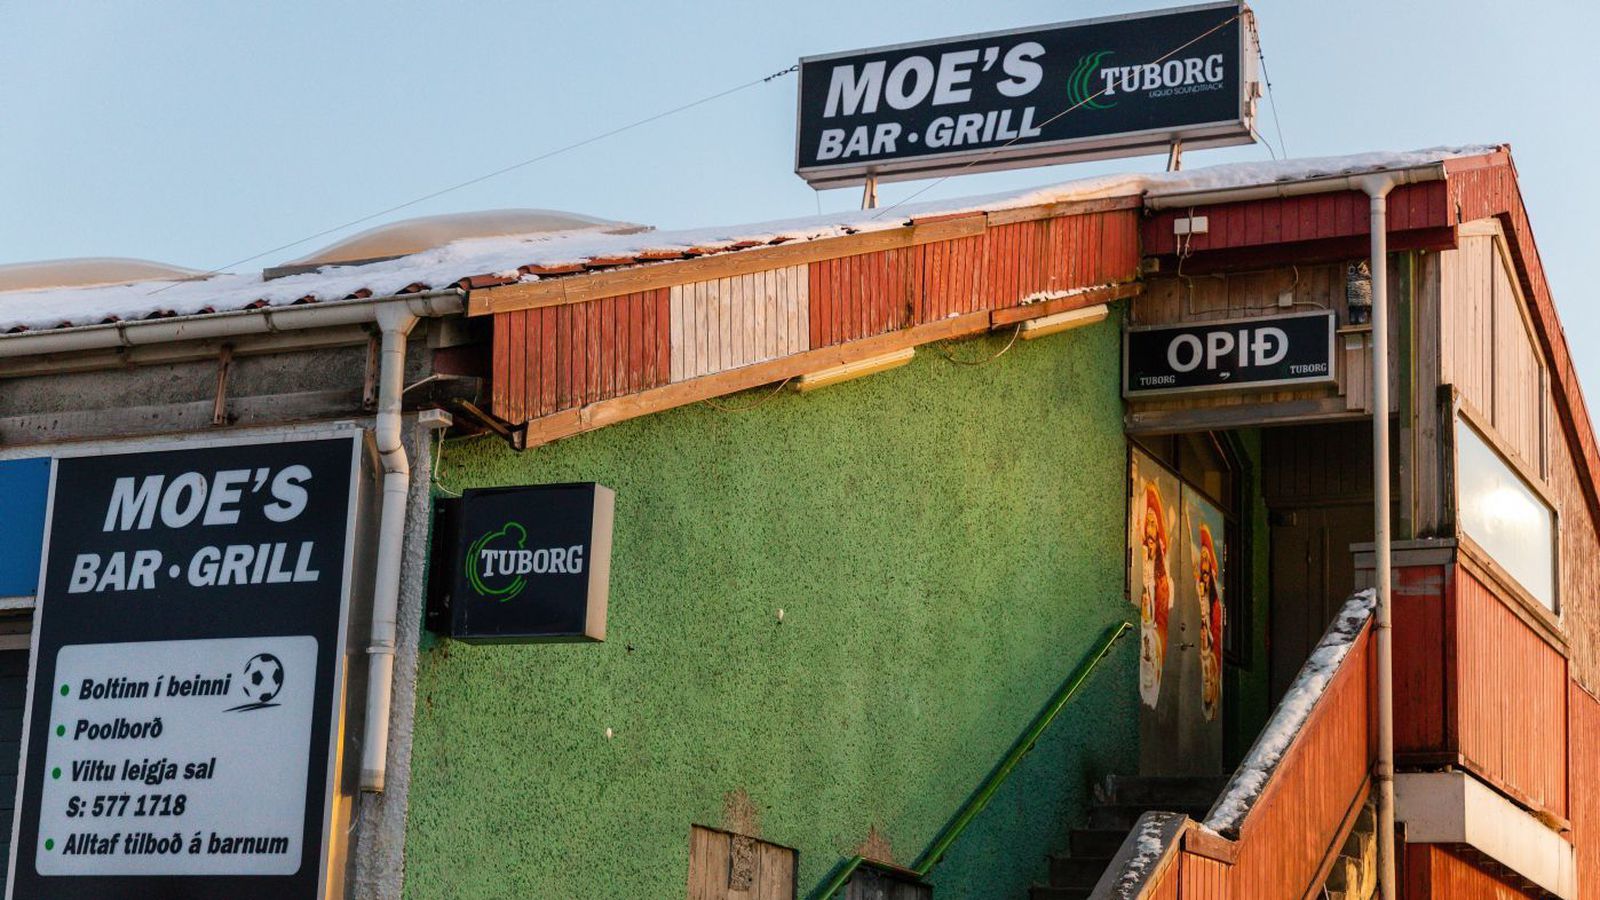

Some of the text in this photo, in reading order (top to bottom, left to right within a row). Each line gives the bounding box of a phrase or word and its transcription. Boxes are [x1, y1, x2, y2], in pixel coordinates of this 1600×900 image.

[823, 41, 1046, 118] MOE'S
[1101, 53, 1224, 95] TUBORG
[1167, 327, 1289, 373] OPIÐ
[1139, 374, 1176, 386] TUBORG
[1290, 362, 1327, 375] TUBORG
[102, 464, 313, 533] MOE'S
[481, 544, 583, 578] TUBORG
[78, 676, 149, 700] Boltinn
[166, 673, 232, 697] beinni
[73, 717, 163, 740] Poolborð
[71, 757, 216, 785] Viltu leigja sal
[65, 793, 187, 818] S: 577 1718
[62, 830, 289, 856] Alltaf tilboð á barnum
